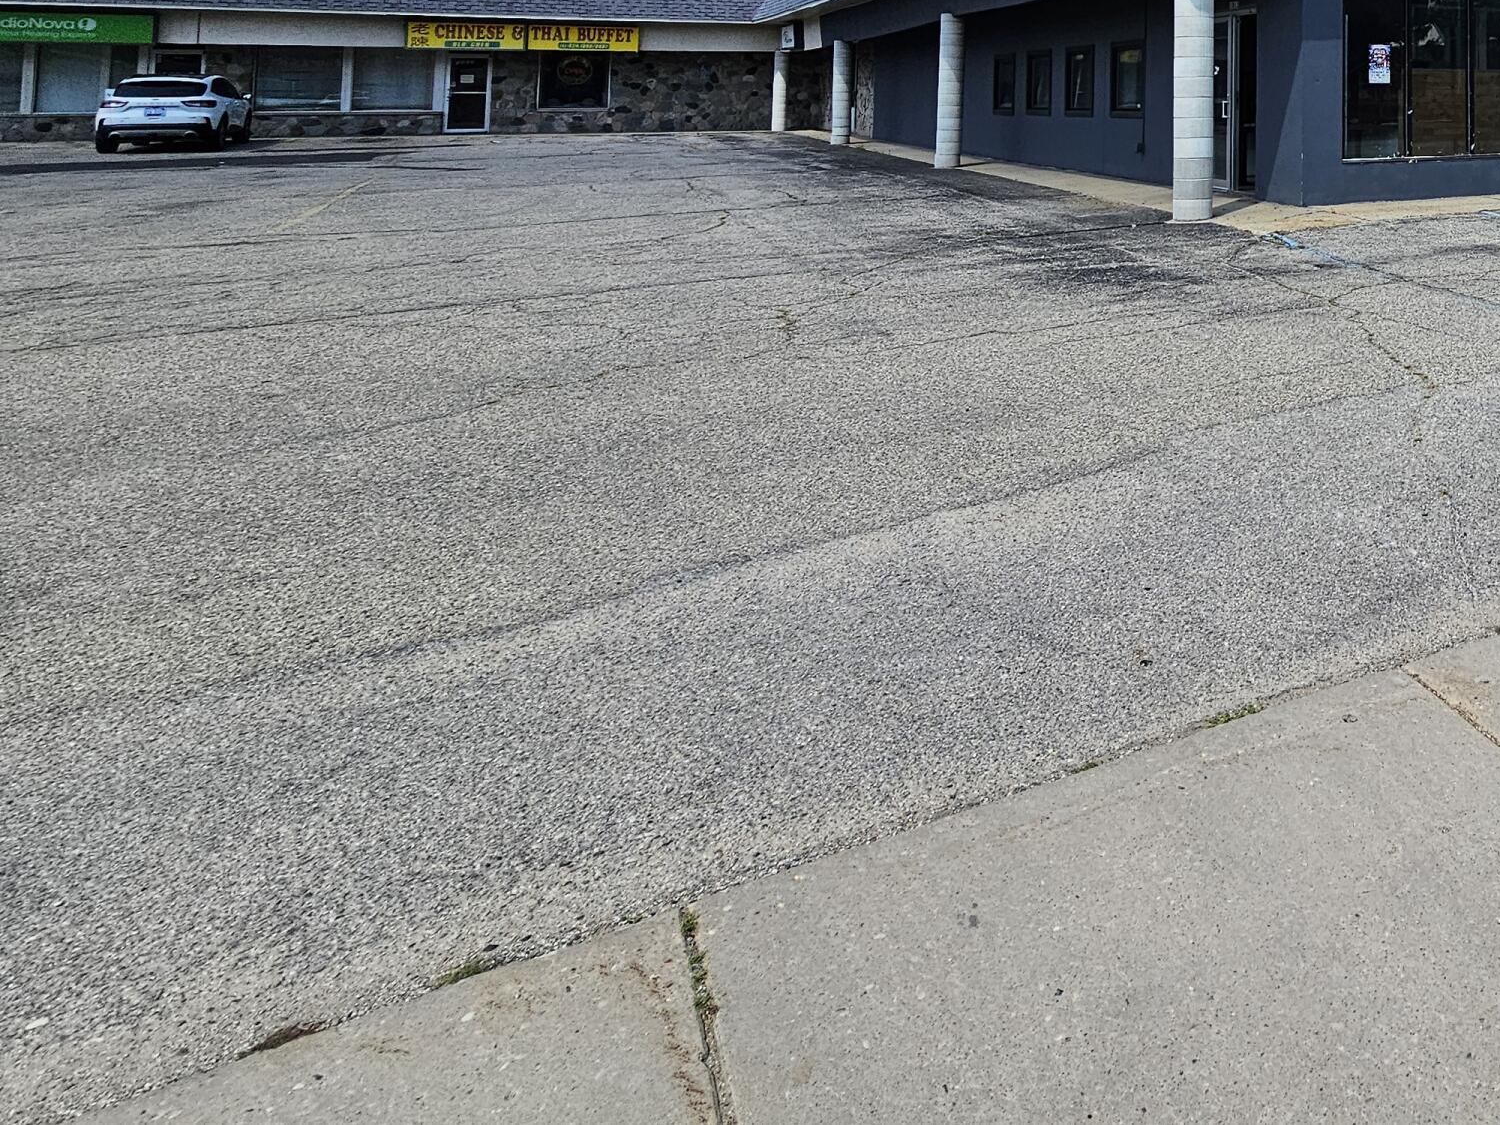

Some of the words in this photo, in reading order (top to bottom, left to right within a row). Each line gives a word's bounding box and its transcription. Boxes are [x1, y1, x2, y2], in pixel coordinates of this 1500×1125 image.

[434, 24, 505, 39] CHINESE
[511, 25, 523, 40] &
[530, 26, 571, 41] THAI
[577, 27, 634, 42] BUFFET
